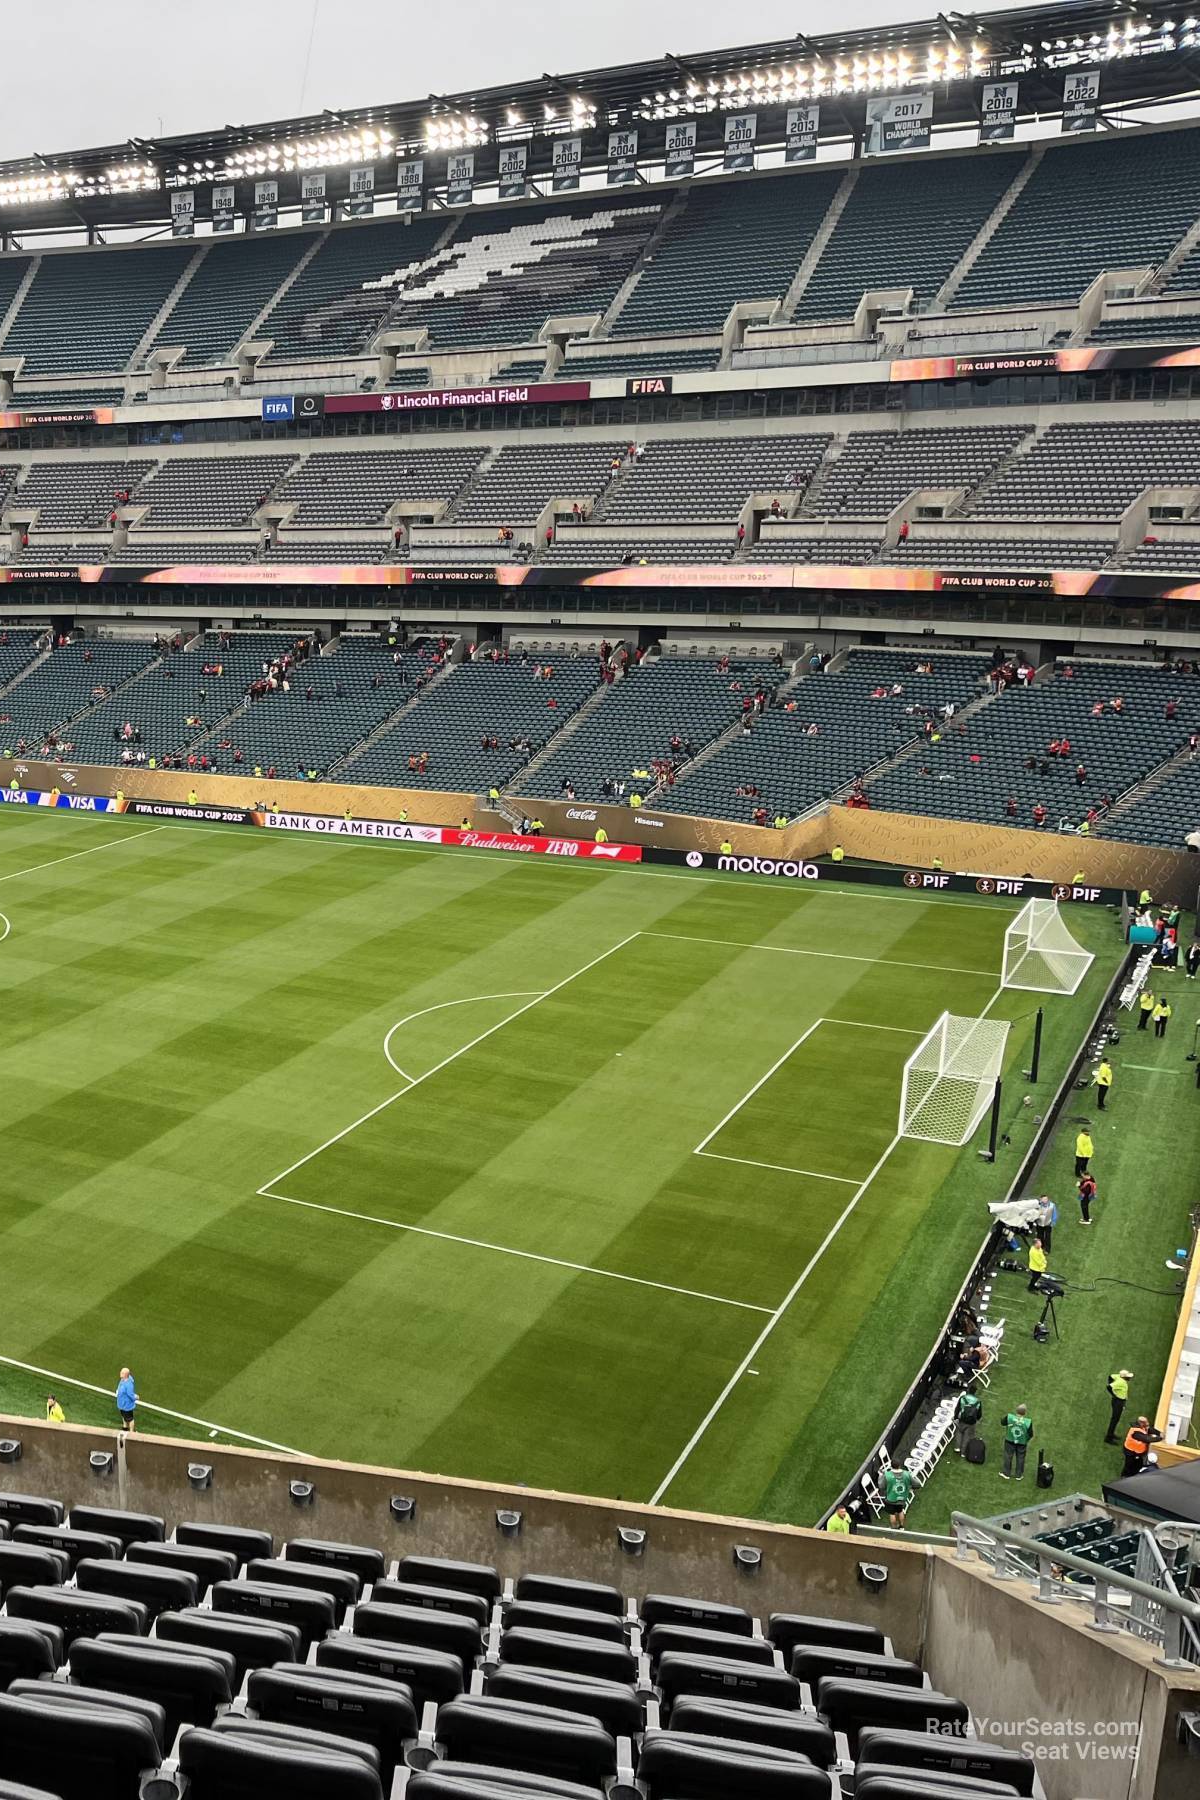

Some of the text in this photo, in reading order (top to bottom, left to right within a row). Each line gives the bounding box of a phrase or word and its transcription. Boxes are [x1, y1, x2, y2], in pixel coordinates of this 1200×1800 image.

[1067, 87, 1095, 101] 2022
[894, 103, 923, 116] 2017
[986, 97, 1013, 110] 2019
[790, 121, 815, 132] 2013
[894, 120, 921, 130] WORLD
[729, 128, 752, 141] 2010
[886, 127, 929, 140] CHAMPIONS
[669, 136, 694, 148] 2006
[610, 143, 635, 157] 2004
[555, 152, 578, 164] 2003
[502, 160, 524, 171] 2002
[401, 173, 419, 184] 1988
[451, 167, 471, 178] 2001
[305, 186, 323, 197] 1960
[352, 180, 371, 191] 1980
[258, 193, 275, 203] 1949
[174, 202, 192, 213] 1947
[957, 362, 974, 371] FIFA
[975, 361, 995, 370] CLUB
[997, 360, 1025, 369] WORLD
[1026, 359, 1042, 367] CUP
[632, 380, 665, 394] FIFA
[397, 387, 528, 408] Lincoln Financial Field
[266, 403, 288, 414] FIFA
[941, 577, 960, 586] FIFA
[961, 578, 983, 586] CLUB
[984, 578, 1017, 587] WORLD
[1019, 579, 1036, 587] CUP
[1, 790, 29, 804] VISA
[68, 795, 96, 810] VISA
[135, 804, 153, 813] FIFA
[154, 805, 171, 815] CLUB
[174, 807, 204, 819] WORLD
[204, 810, 221, 820] CUP
[565, 808, 597, 821] Coca-Cola
[269, 815, 413, 839] BANK OF AMERICA
[634, 816, 664, 827] Hisense
[458, 829, 579, 856] Budweiser ZERO
[717, 855, 819, 880] motorola
[923, 874, 949, 889] PIF
[995, 880, 1024, 895] PIF
[1072, 887, 1101, 902] PIF
